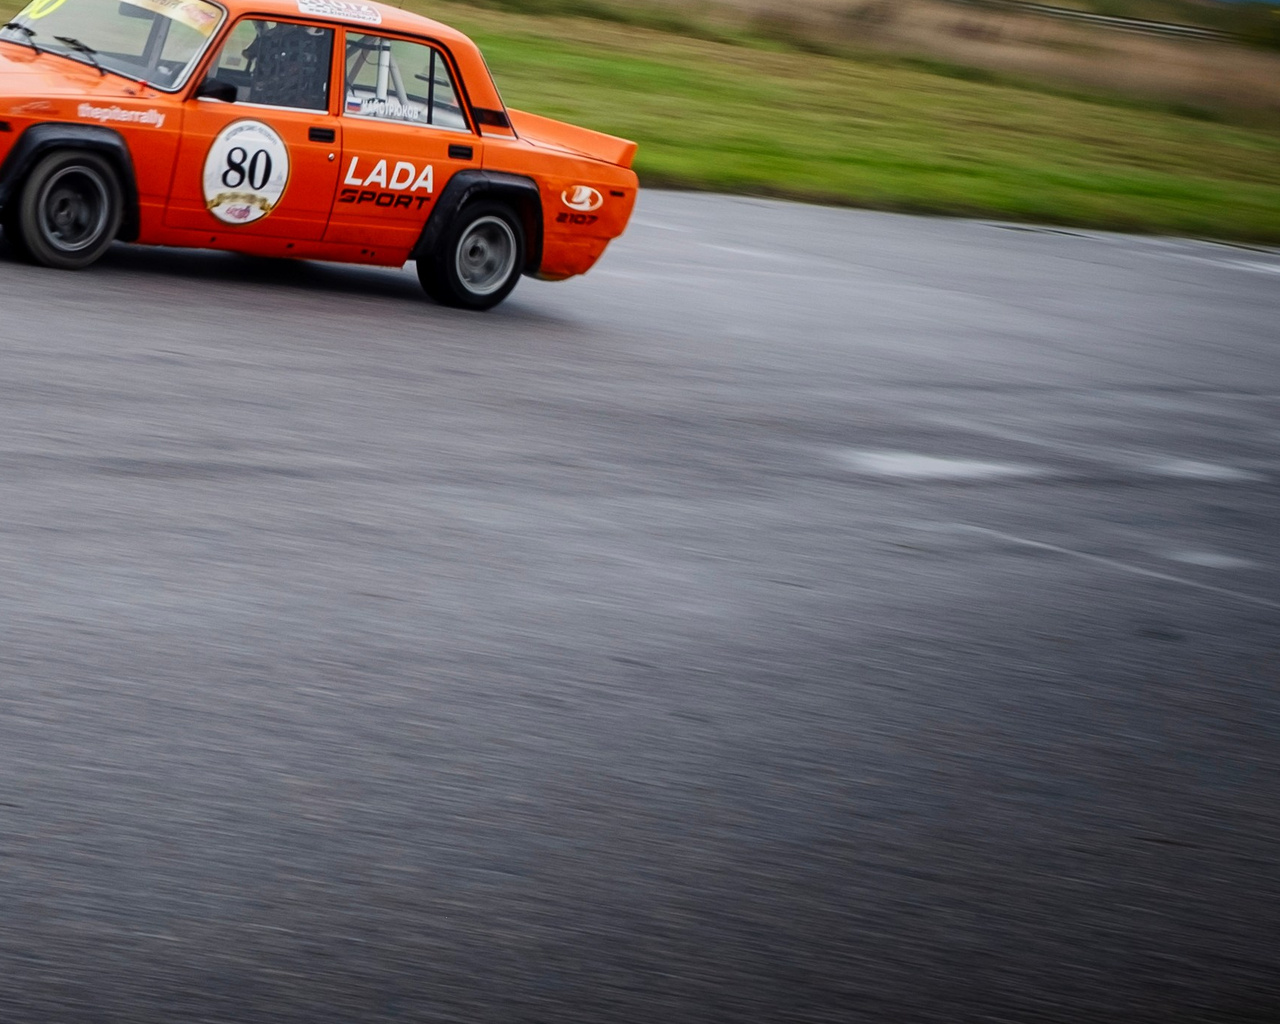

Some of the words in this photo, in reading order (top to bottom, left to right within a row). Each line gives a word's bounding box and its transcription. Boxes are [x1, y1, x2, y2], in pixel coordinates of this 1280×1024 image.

[222, 146, 272, 191] 80
[344, 156, 433, 193] LADA
[338, 189, 431, 209] SPORT
[556, 212, 598, 225] 2107
